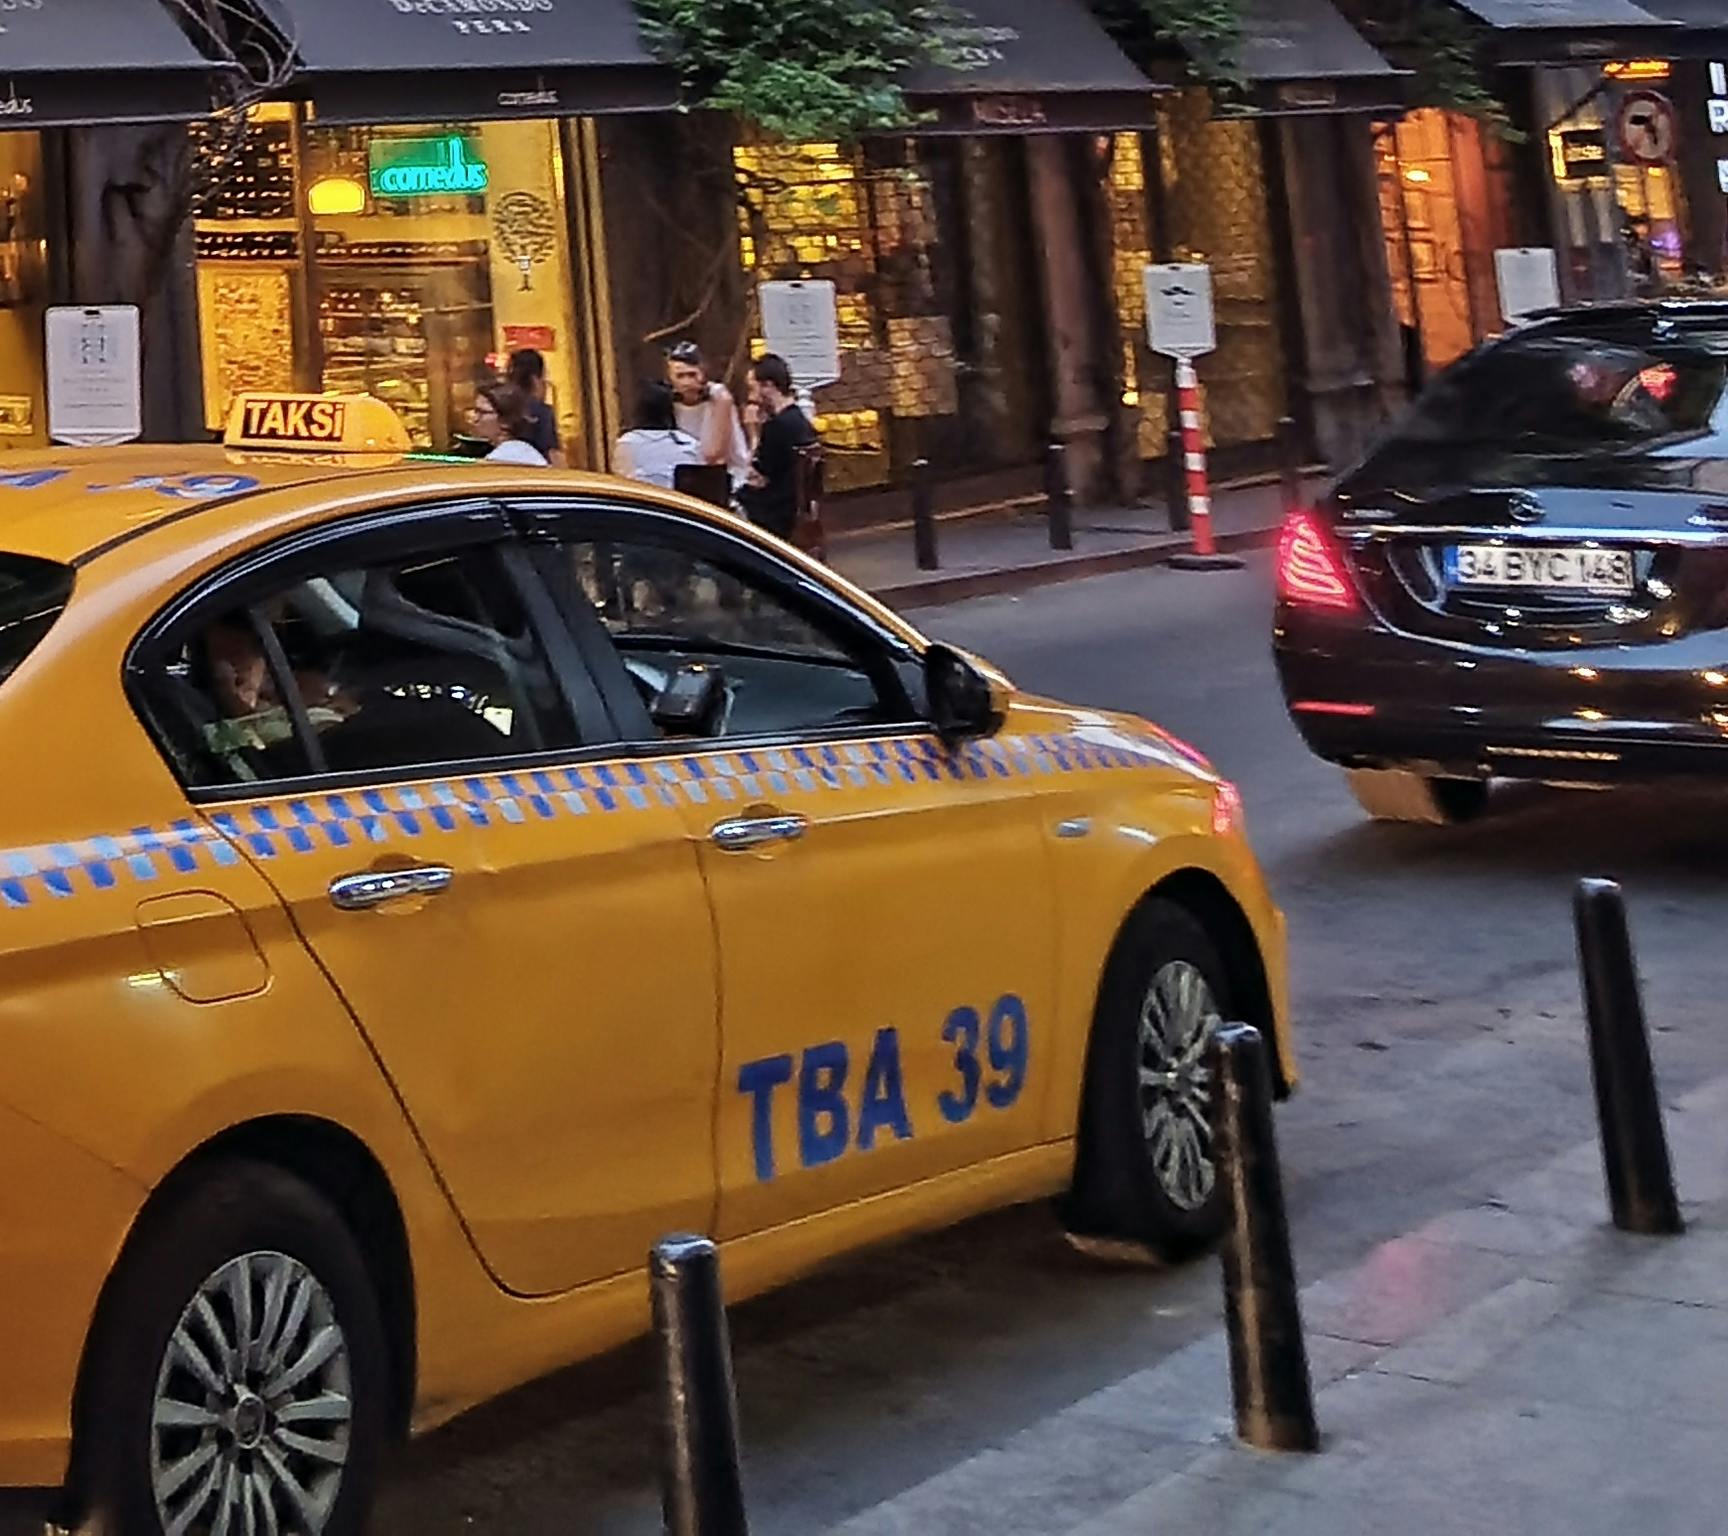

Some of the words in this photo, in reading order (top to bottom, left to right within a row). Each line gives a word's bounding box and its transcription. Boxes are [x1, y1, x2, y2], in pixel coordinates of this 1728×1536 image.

[379, 136, 489, 193] comedus
[1459, 549, 1497, 580] 34
[1506, 550, 1570, 582] BYC
[738, 1026, 914, 1182] TBA
[938, 993, 1028, 1124] 39
